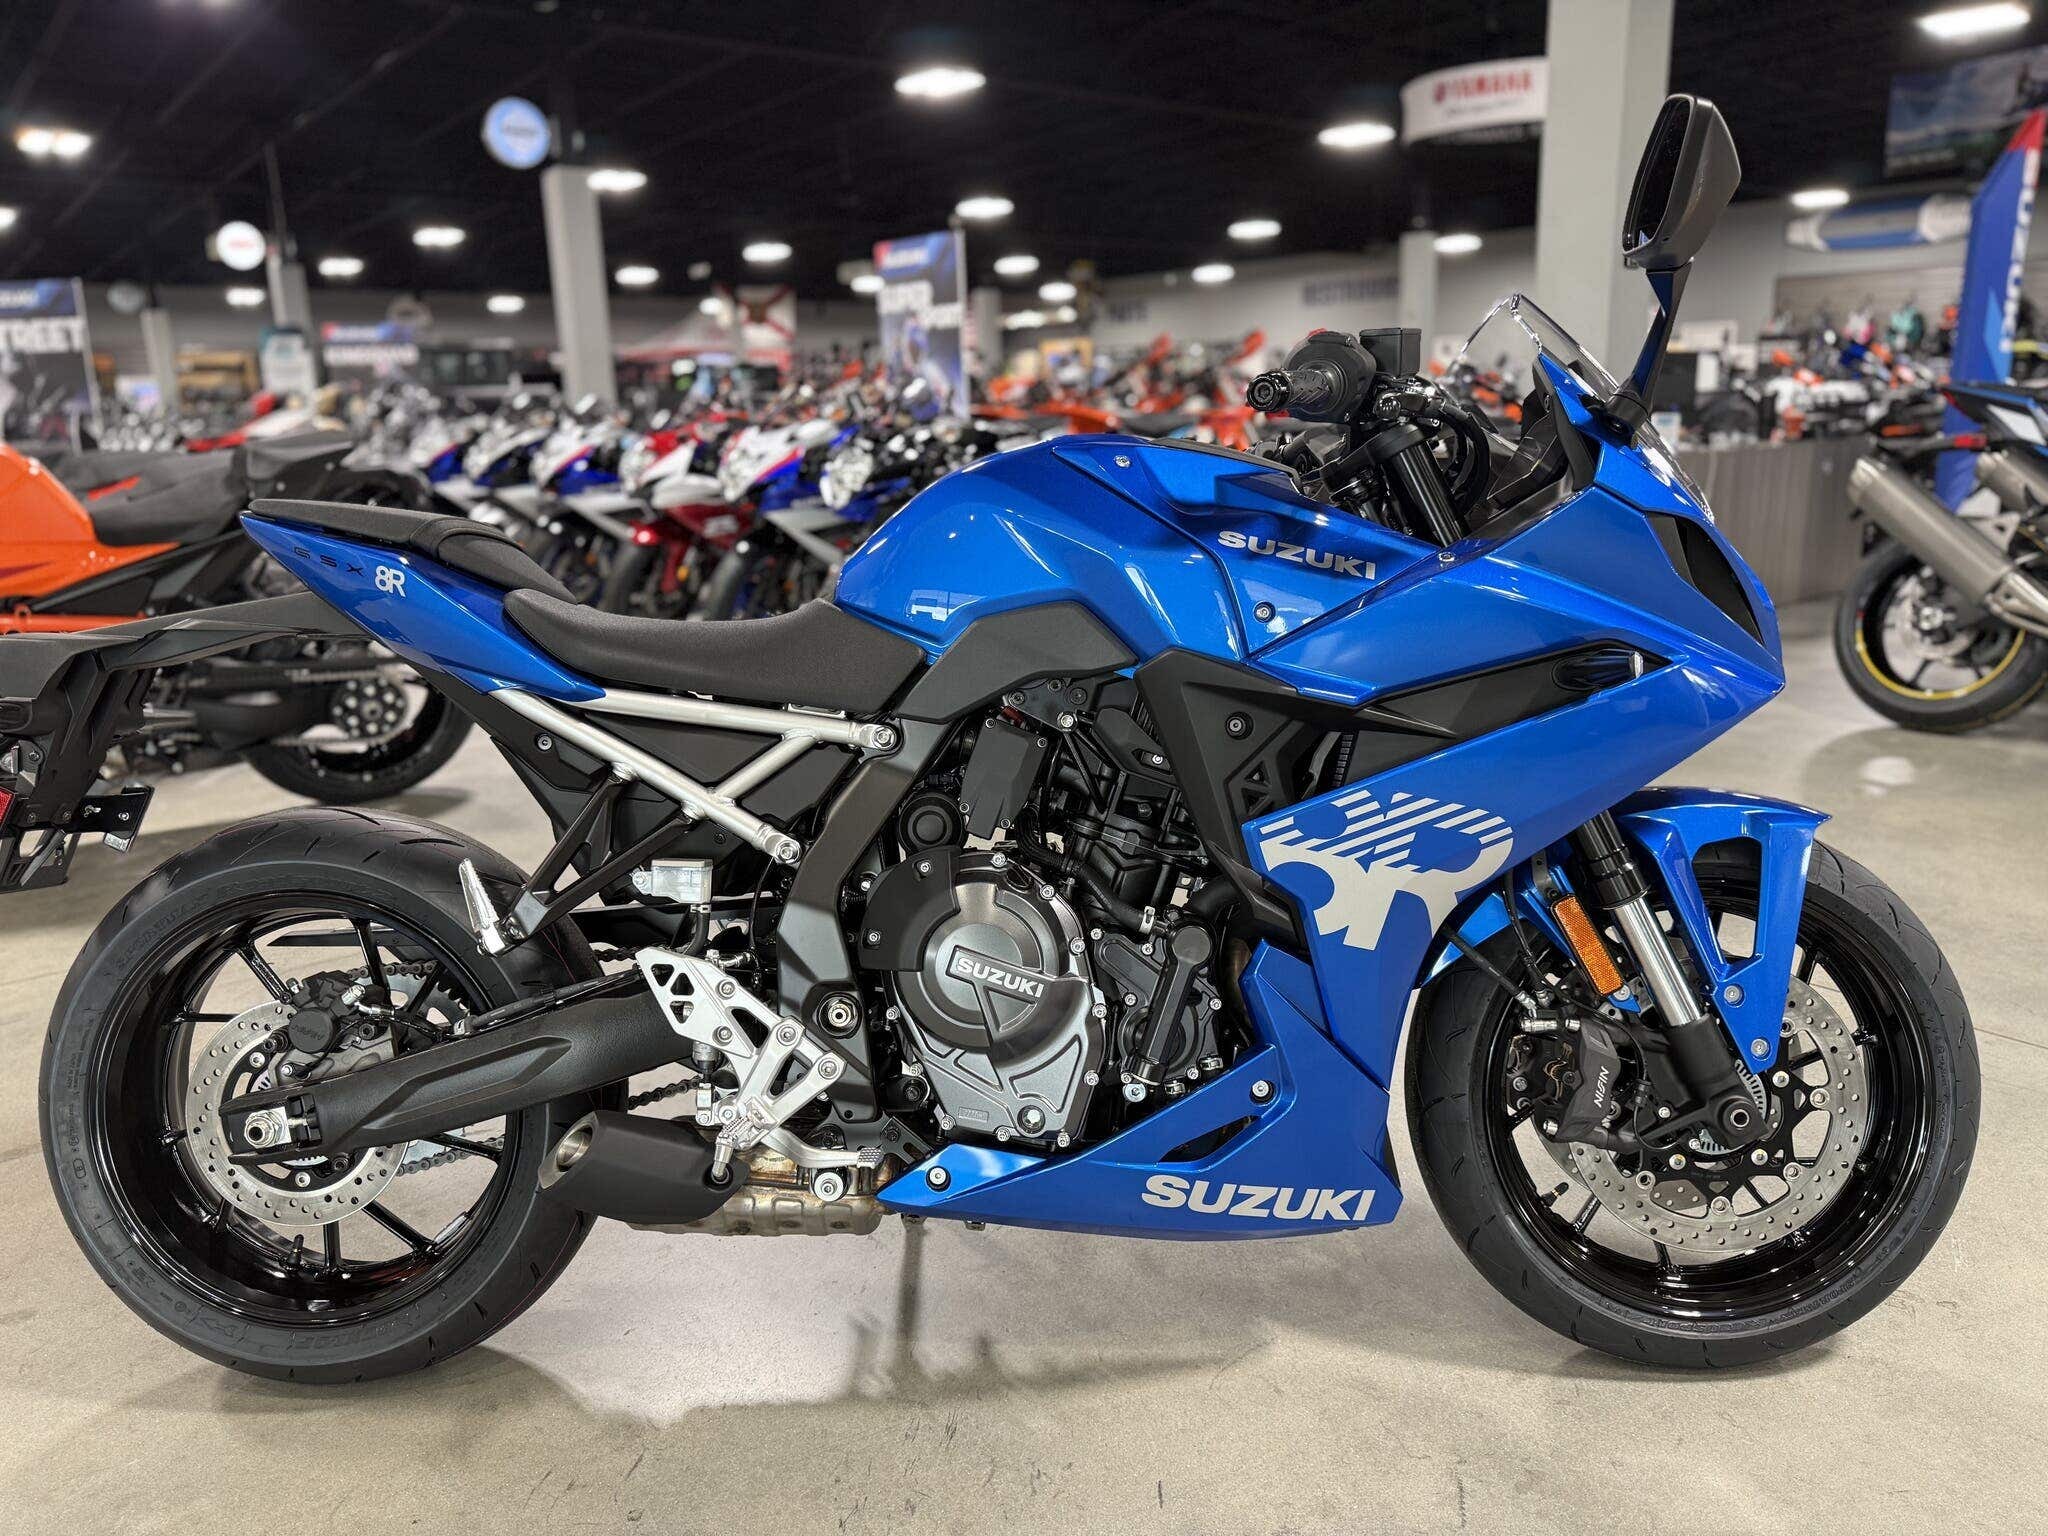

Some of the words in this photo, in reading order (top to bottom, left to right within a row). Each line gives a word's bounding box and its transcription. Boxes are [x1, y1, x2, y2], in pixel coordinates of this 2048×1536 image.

[1218, 530, 1376, 580] SUZUKI
[375, 565, 406, 598] 8R
[957, 957, 1044, 997] SUZUKI
[1593, 1066, 1610, 1108] NISSIN
[1142, 1174, 1376, 1221] SUZUKI
